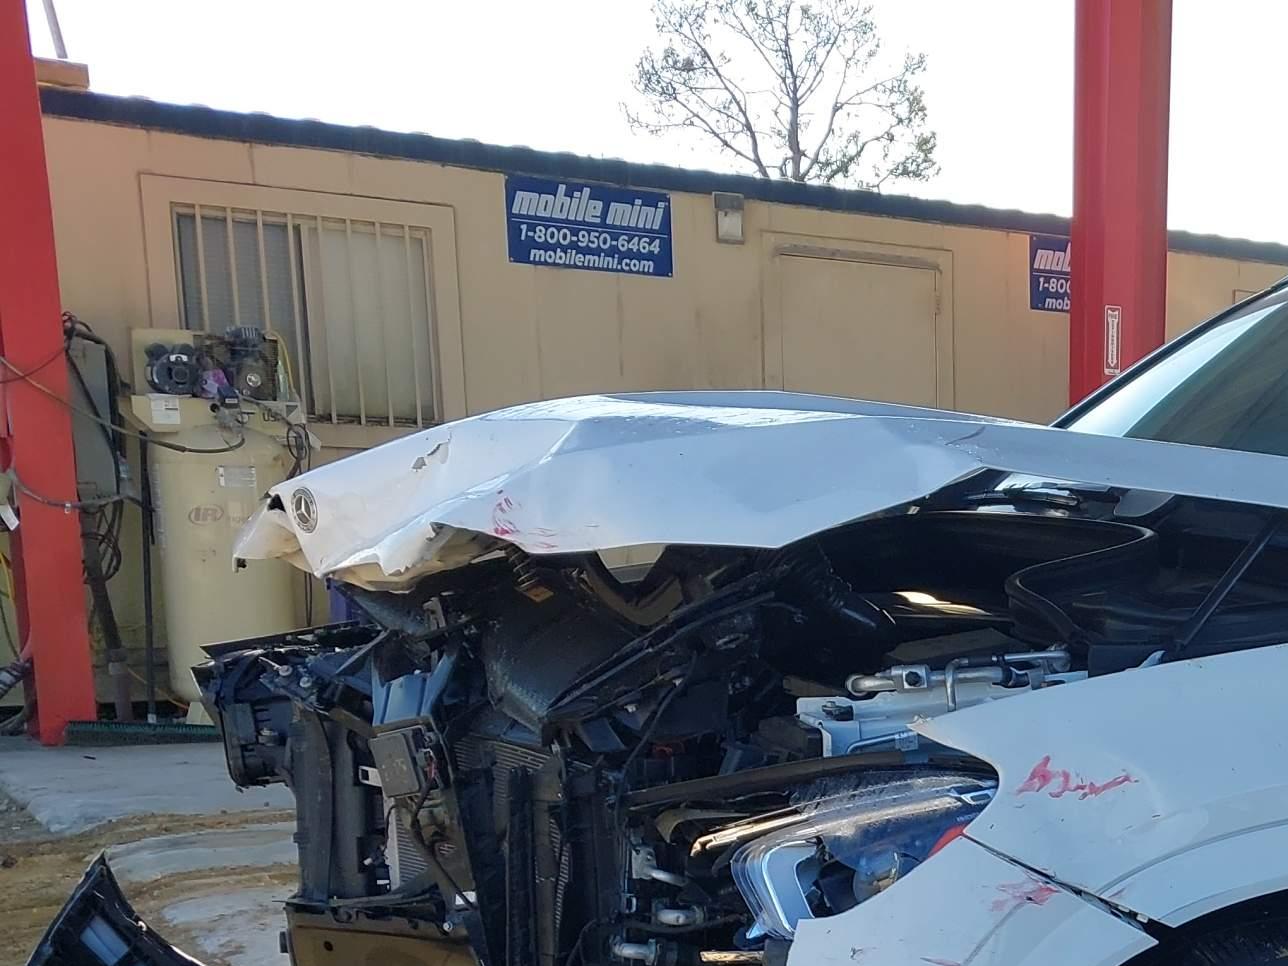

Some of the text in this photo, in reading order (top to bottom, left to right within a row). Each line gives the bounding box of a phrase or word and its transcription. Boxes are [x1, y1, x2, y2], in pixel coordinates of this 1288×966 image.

[511, 183, 664, 229] mobile mini
[519, 223, 661, 255] 1-800-950-6464
[529, 248, 654, 273] mobilemini.com
